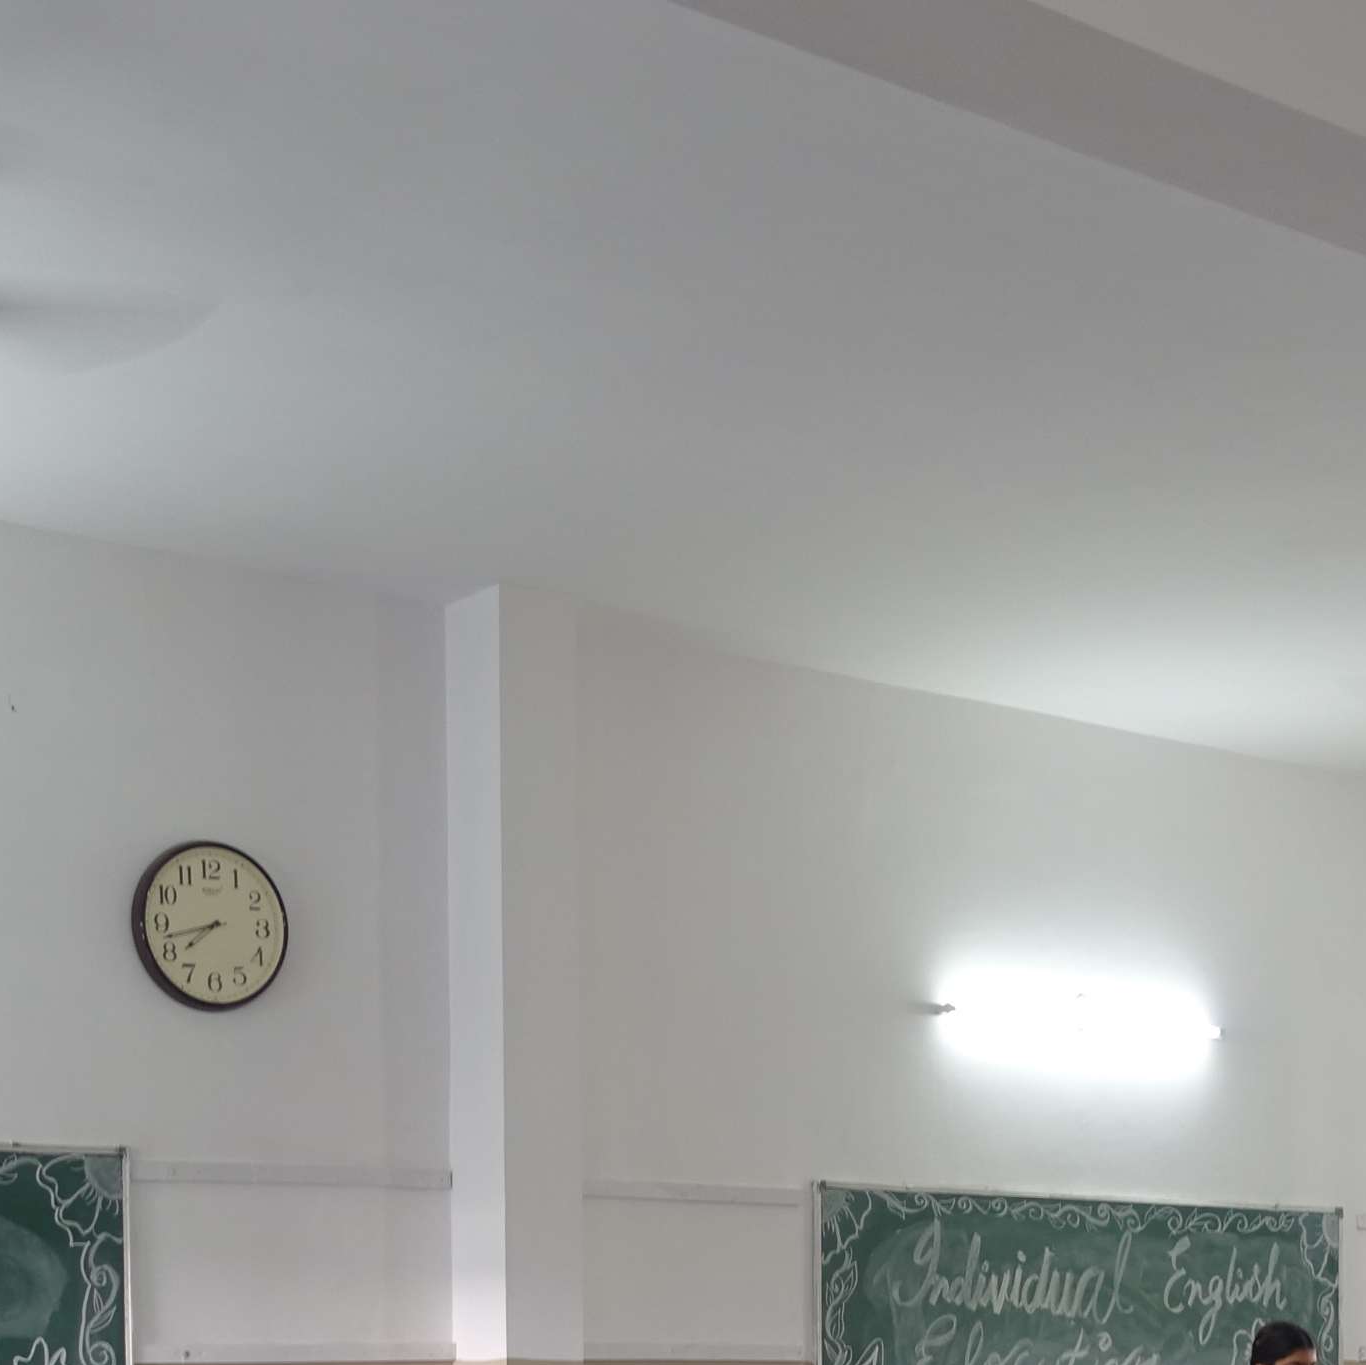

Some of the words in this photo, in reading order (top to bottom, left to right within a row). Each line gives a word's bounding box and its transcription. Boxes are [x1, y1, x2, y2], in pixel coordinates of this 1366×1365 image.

[179, 864, 192, 886] 11
[201, 859, 221, 880] 12
[233, 868, 239, 889] 1
[159, 884, 177, 905] 10
[249, 890, 261, 911] 2
[154, 912, 170, 933] 9
[255, 919, 270, 939] 3
[162, 941, 177, 961] 8
[181, 963, 196, 984] 7
[207, 972, 223, 993] 6
[233, 966, 247, 986] 5
[892, 1215, 1134, 1325] Individual
[1163, 1235, 1287, 1346] English
